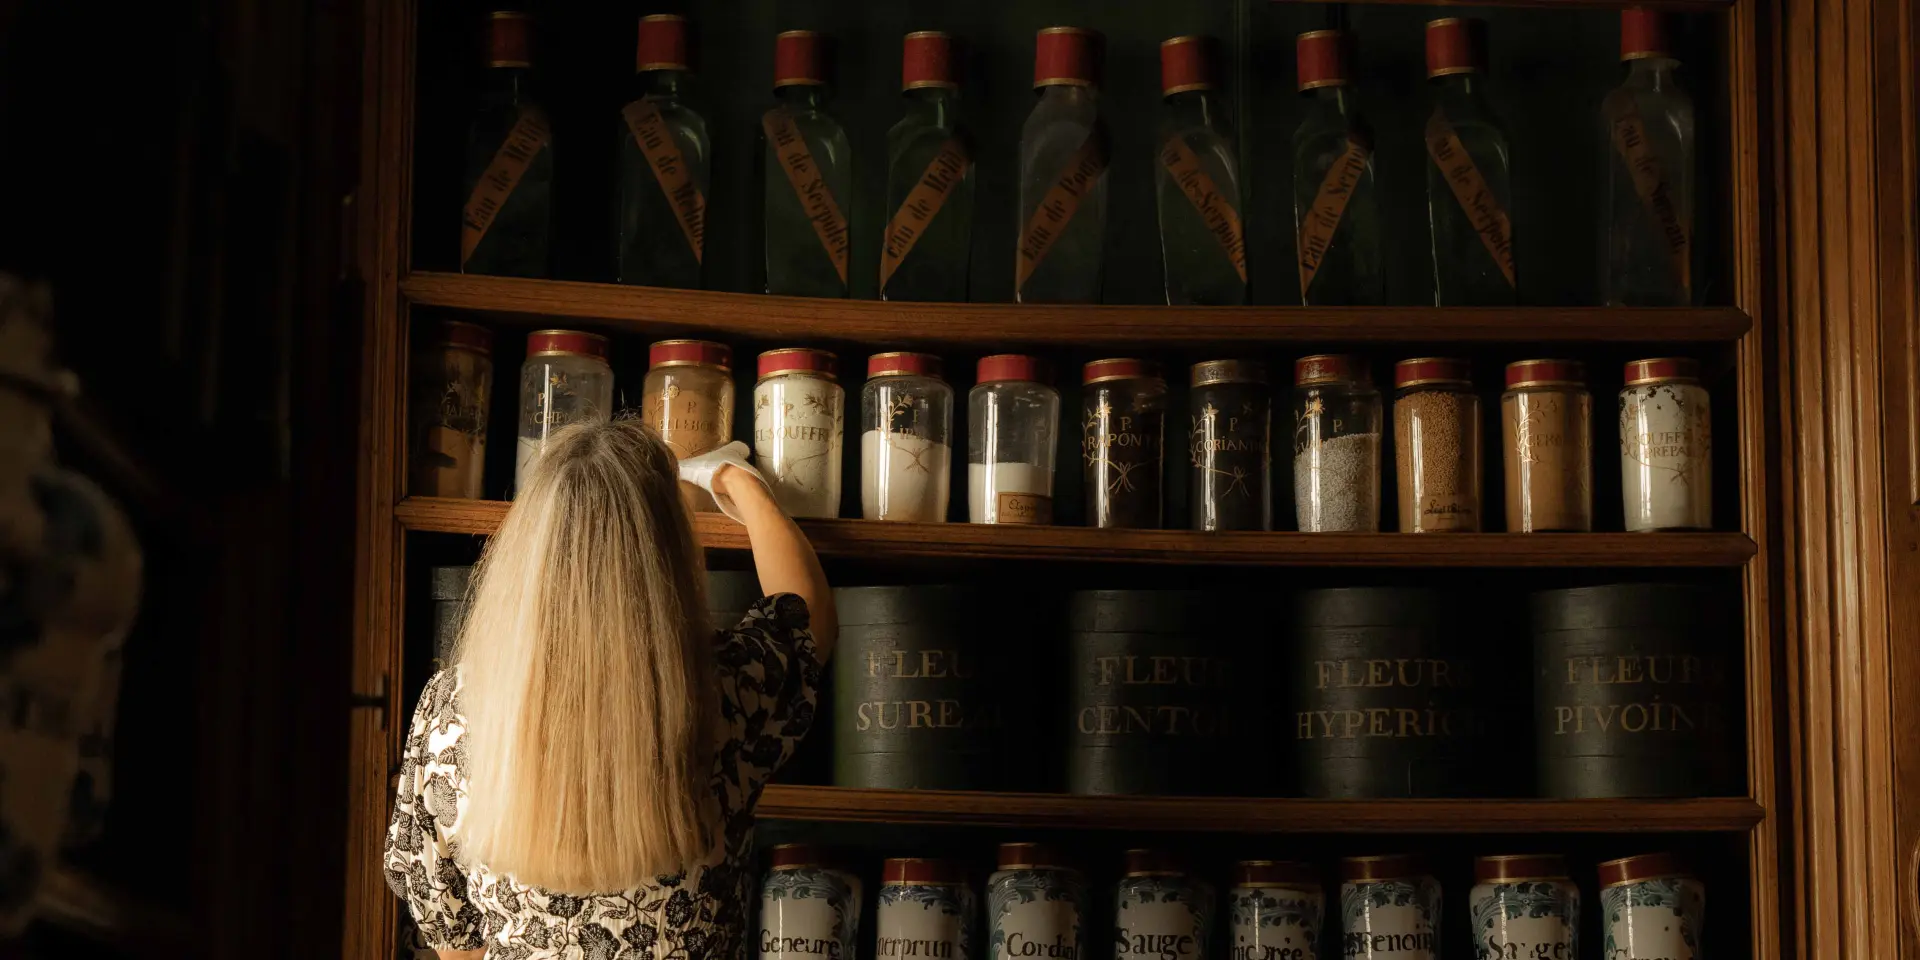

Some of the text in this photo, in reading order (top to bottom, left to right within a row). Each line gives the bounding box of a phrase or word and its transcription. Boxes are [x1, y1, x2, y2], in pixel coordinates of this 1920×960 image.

[635, 111, 662, 149] Eau
[655, 154, 679, 176] de
[786, 151, 811, 174] de
[486, 168, 512, 192] de
[1178, 168, 1204, 195] de
[1449, 164, 1474, 187] de
[906, 198, 933, 221] de
[1043, 198, 1068, 224] de
[1313, 205, 1339, 229] de
[1117, 927, 1194, 960] Sauge
